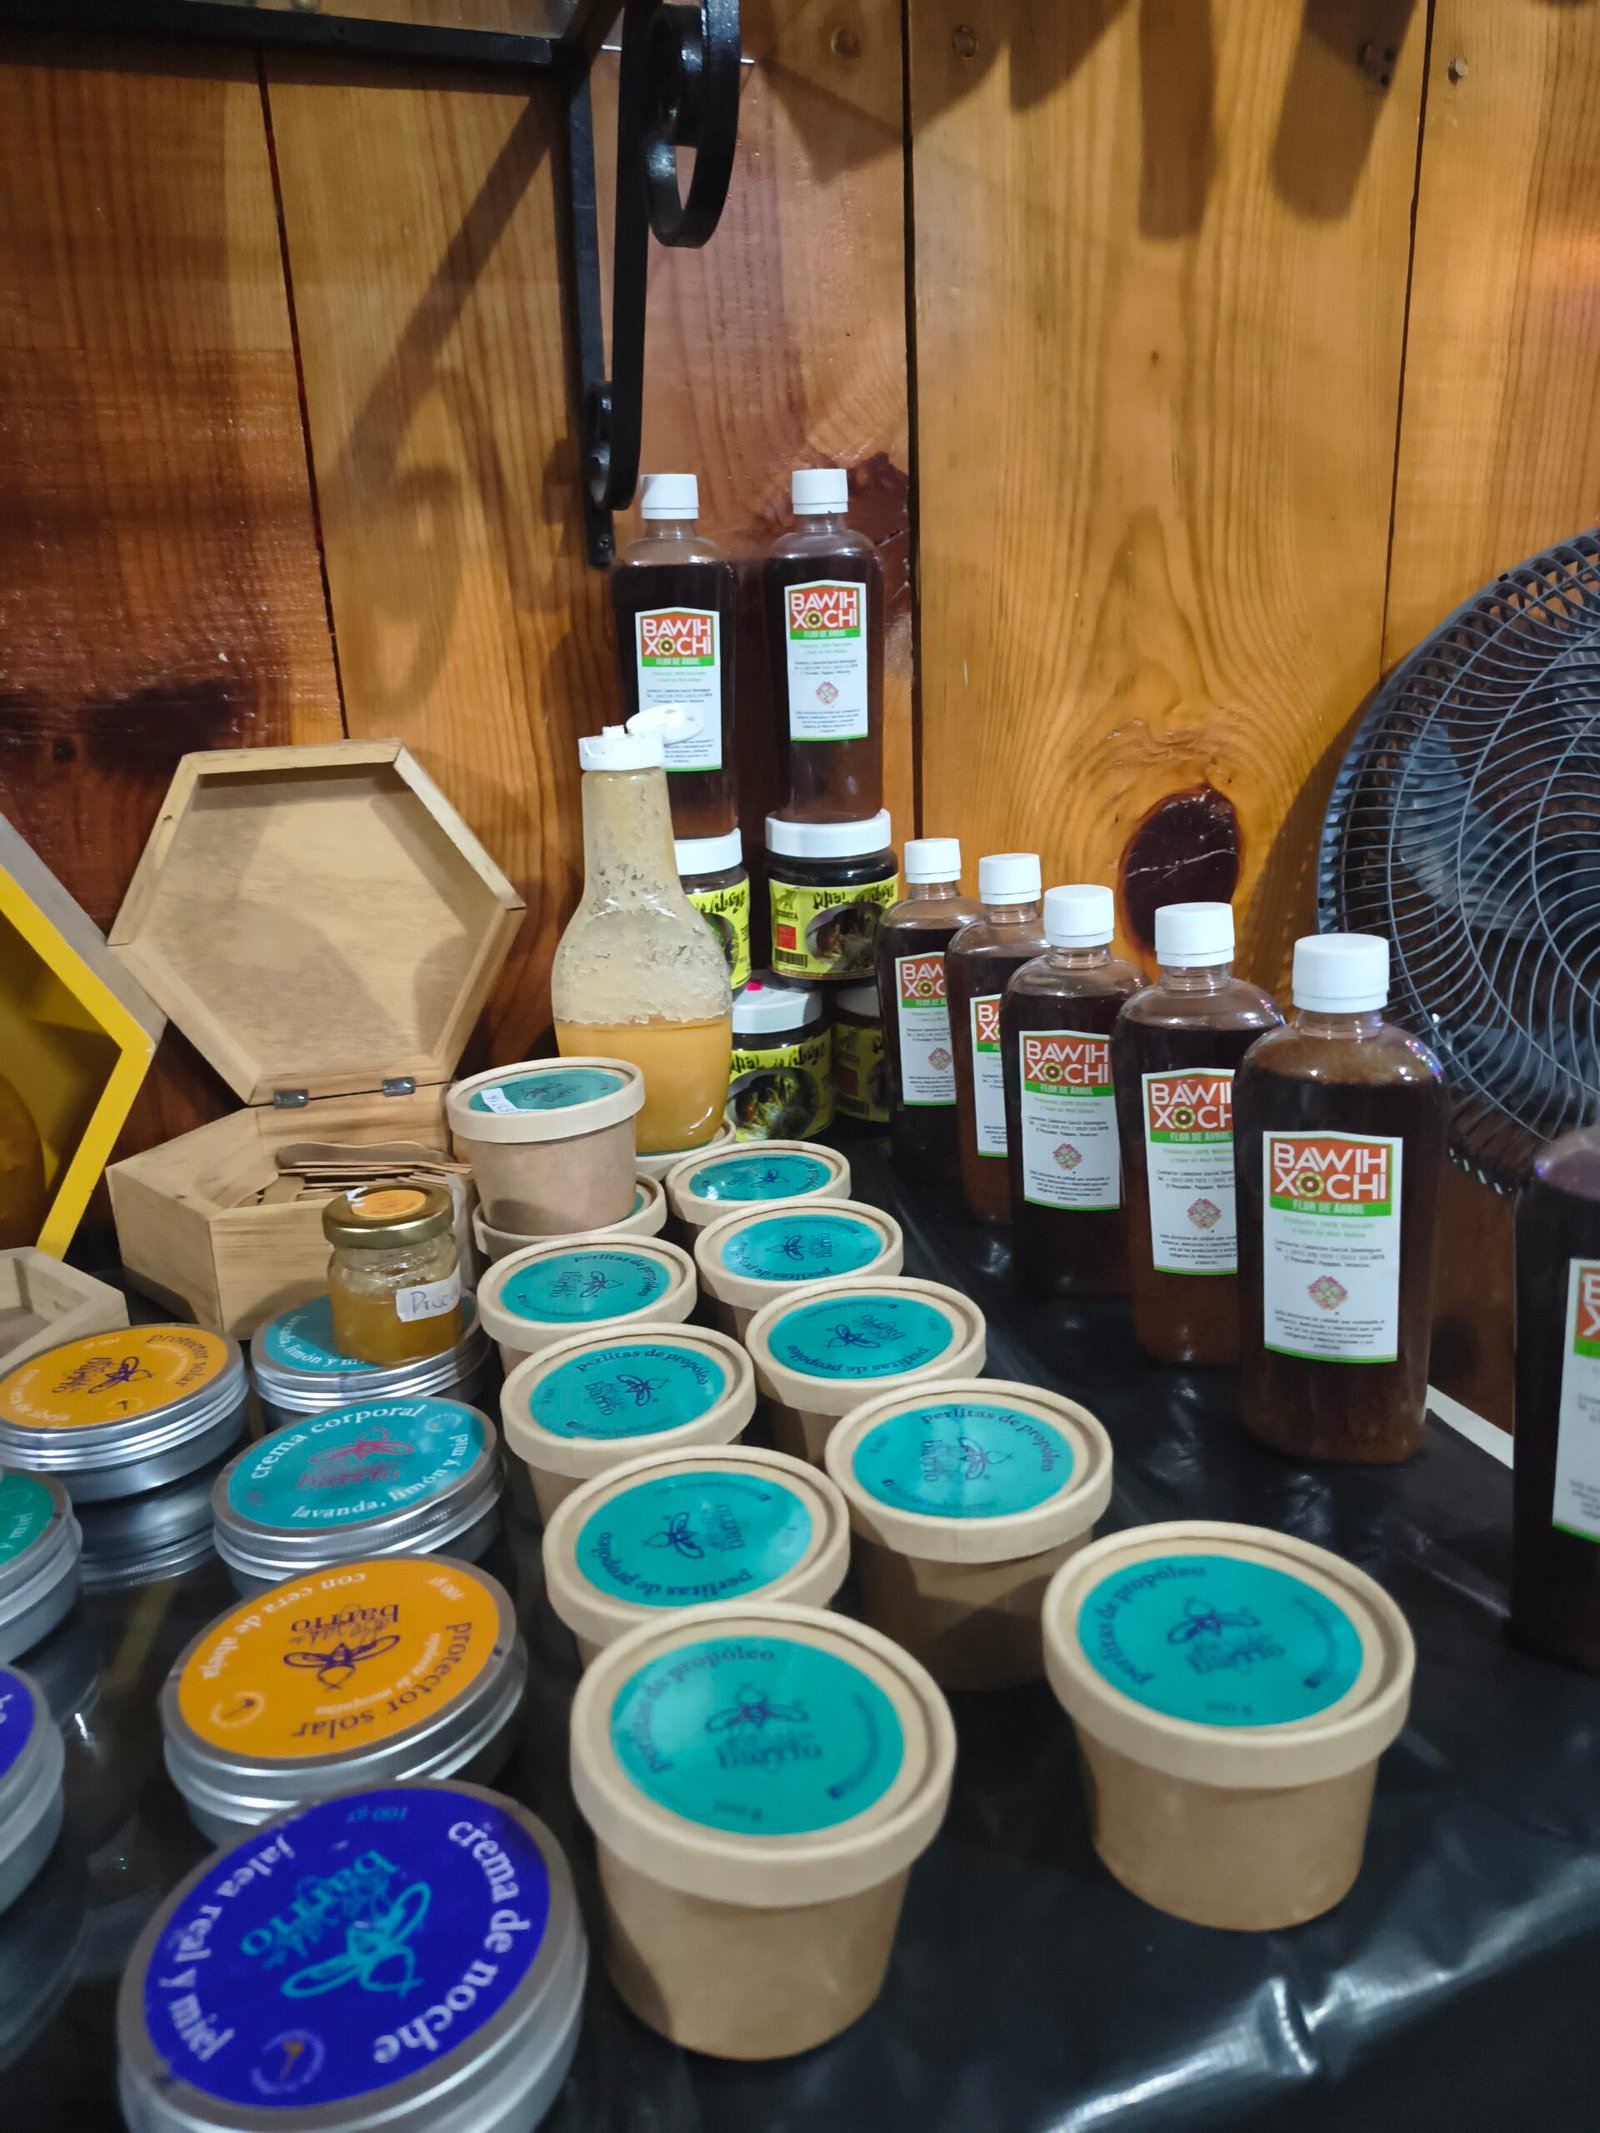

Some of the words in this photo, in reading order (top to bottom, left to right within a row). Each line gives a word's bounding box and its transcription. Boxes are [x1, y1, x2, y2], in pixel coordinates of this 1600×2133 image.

[790, 591, 857, 610] BAWIH
[642, 618, 711, 637] BAWIH
[792, 608, 857, 629] XOCHI
[644, 636, 711, 656] XOCHI
[901, 962, 945, 980] BAW
[1025, 1039, 1109, 1063] BAWIH
[1027, 1059, 1109, 1084] XOCHI
[1150, 1081, 1232, 1105] BAWI
[1273, 1142, 1387, 1174] BAWIH
[1274, 1168, 1386, 1200] XOCHI
[286, 1344, 323, 1365] limón
[575, 1350, 640, 1372] perlitas
[644, 1349, 665, 1358] de
[920, 1407, 995, 1425] perlitas
[998, 1409, 1020, 1426] de
[251, 1433, 309, 1480] crema
[310, 1404, 427, 1434] corporal
[448, 1433, 469, 1458] miel
[442, 1458, 461, 1470] y
[388, 1466, 448, 1501] limón
[291, 1500, 387, 1519] lavanda,
[319, 1571, 367, 1590] con
[635, 1579, 663, 1597] de
[666, 1567, 754, 1596] perlitas
[261, 1585, 314, 1615] cera
[234, 1614, 262, 1634] de
[290, 1604, 399, 1633] barrio
[387, 1621, 473, 1715] protector
[290, 1710, 375, 1740] solar
[447, 1820, 521, 1904] crema
[173, 1905, 223, 1962] real
[483, 1908, 531, 1954] de
[158, 1968, 197, 1988] y
[372, 1958, 499, 2064] noche
[169, 1993, 236, 2063] miel
